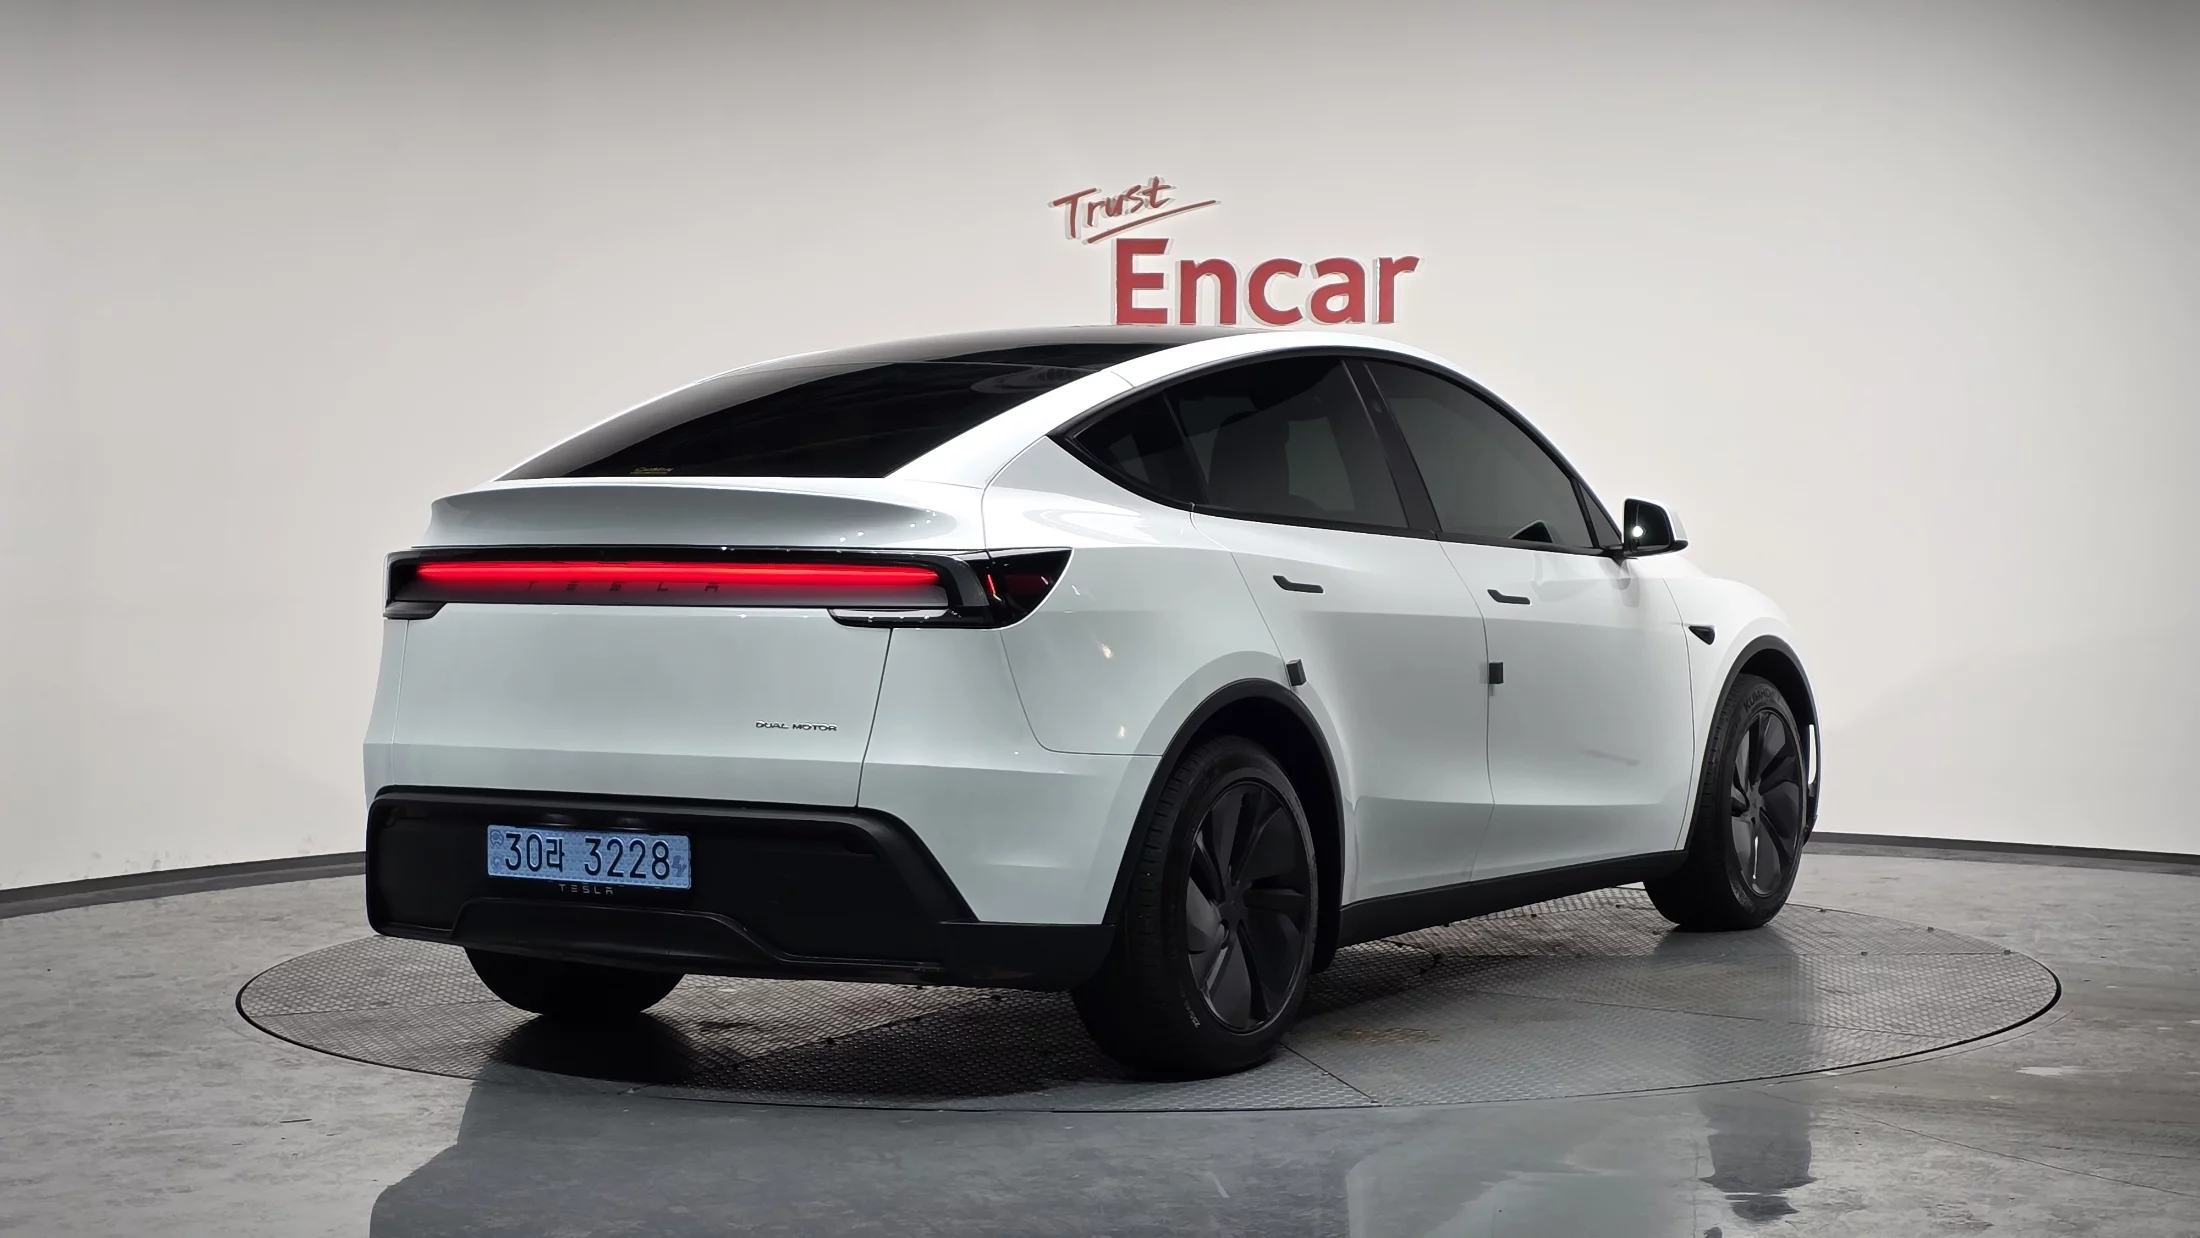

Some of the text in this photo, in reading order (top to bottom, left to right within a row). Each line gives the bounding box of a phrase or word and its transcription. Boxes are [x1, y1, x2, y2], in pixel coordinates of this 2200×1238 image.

[1051, 176, 1174, 239] Trust
[1113, 237, 1423, 326] Encar
[526, 579, 721, 593] TESLA
[1743, 687, 1771, 714] KUMHO
[755, 721, 838, 732] DUAL MOTOR
[504, 831, 565, 873] 30라
[584, 836, 671, 880] 3228
[558, 883, 614, 896] TESLA
